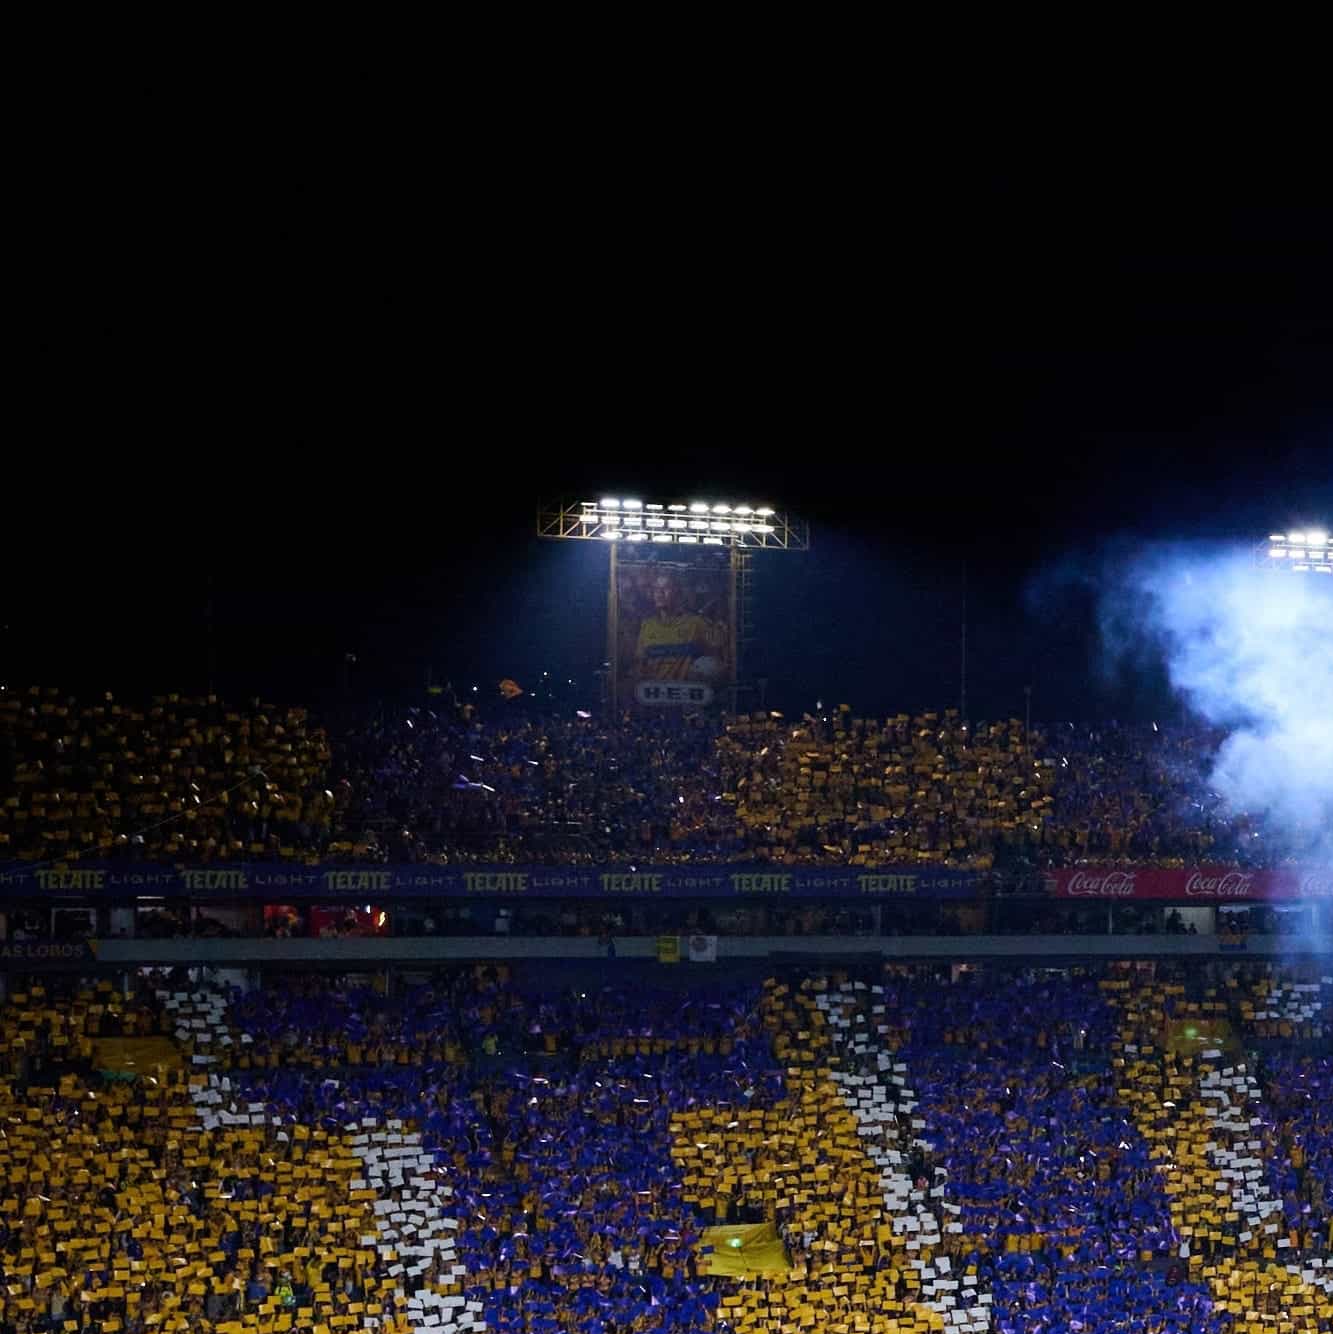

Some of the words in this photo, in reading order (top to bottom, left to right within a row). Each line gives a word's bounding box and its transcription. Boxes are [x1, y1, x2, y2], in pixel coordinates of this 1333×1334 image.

[37, 869, 105, 888] TECATE
[183, 869, 248, 888] TECATE
[326, 869, 391, 888] TECATE
[465, 871, 528, 890] TECATE
[601, 872, 663, 890] TECATE
[731, 873, 791, 891] TECATE
[858, 873, 916, 891] TECATE
[1068, 873, 1135, 896] Coca-Cola
[1184, 873, 1253, 896] Coca-Cola
